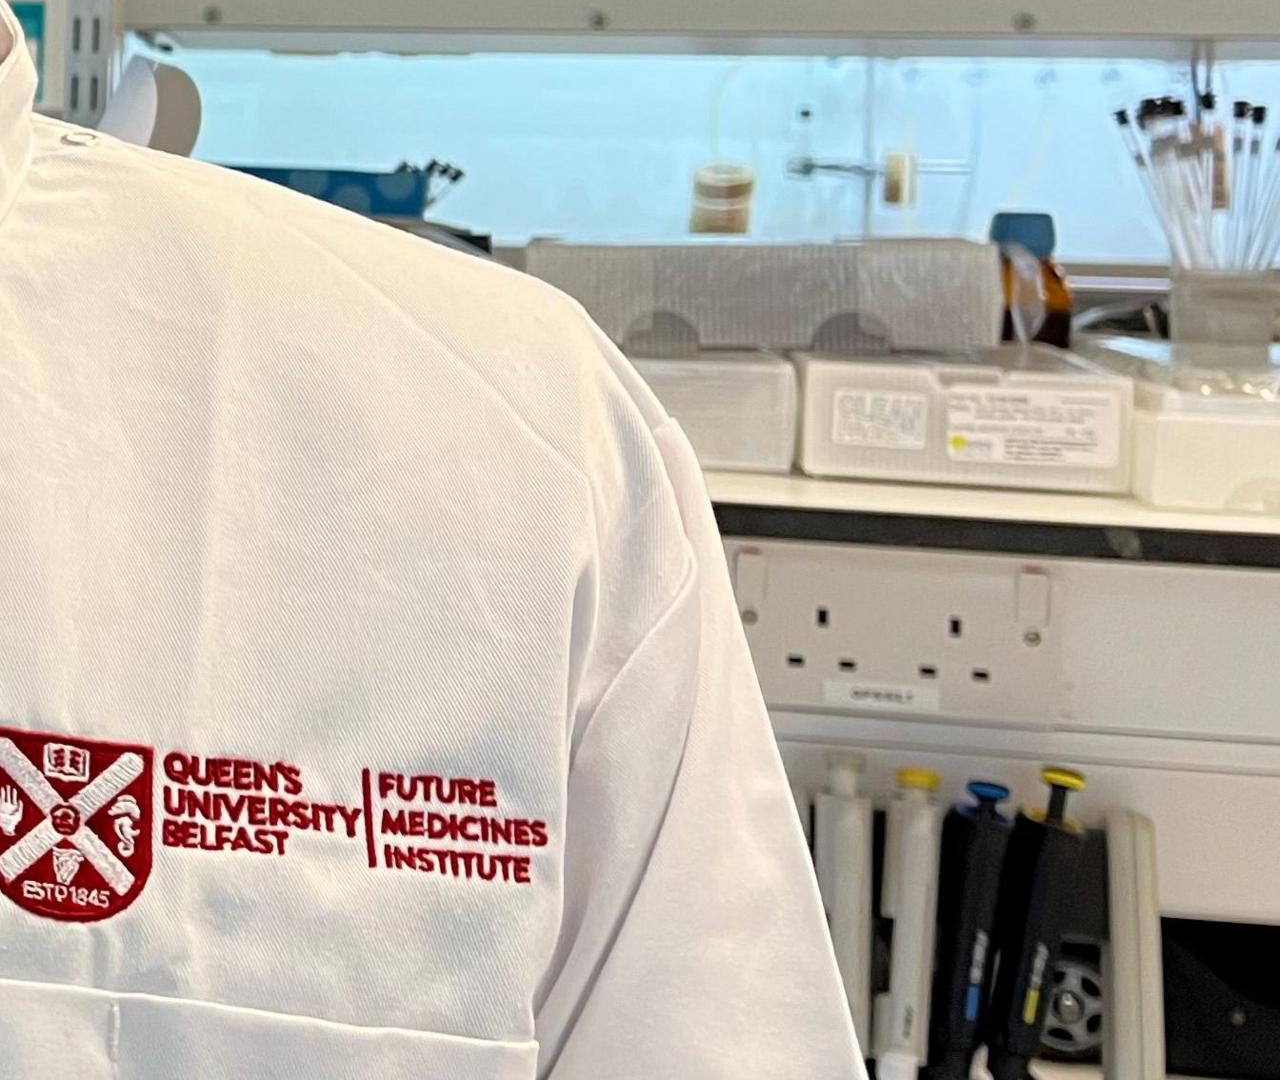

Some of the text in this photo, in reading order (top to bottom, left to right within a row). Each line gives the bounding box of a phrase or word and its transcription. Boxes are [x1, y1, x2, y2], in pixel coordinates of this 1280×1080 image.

[162, 752, 303, 796] QUEEN'S
[378, 772, 498, 808] FUTURE
[162, 786, 363, 838] UNIVERSITY
[381, 808, 549, 848] MEDICINES
[162, 819, 290, 856] BELFAST
[384, 844, 532, 884] INSTITUTE
[69, 886, 111, 908] 1845
